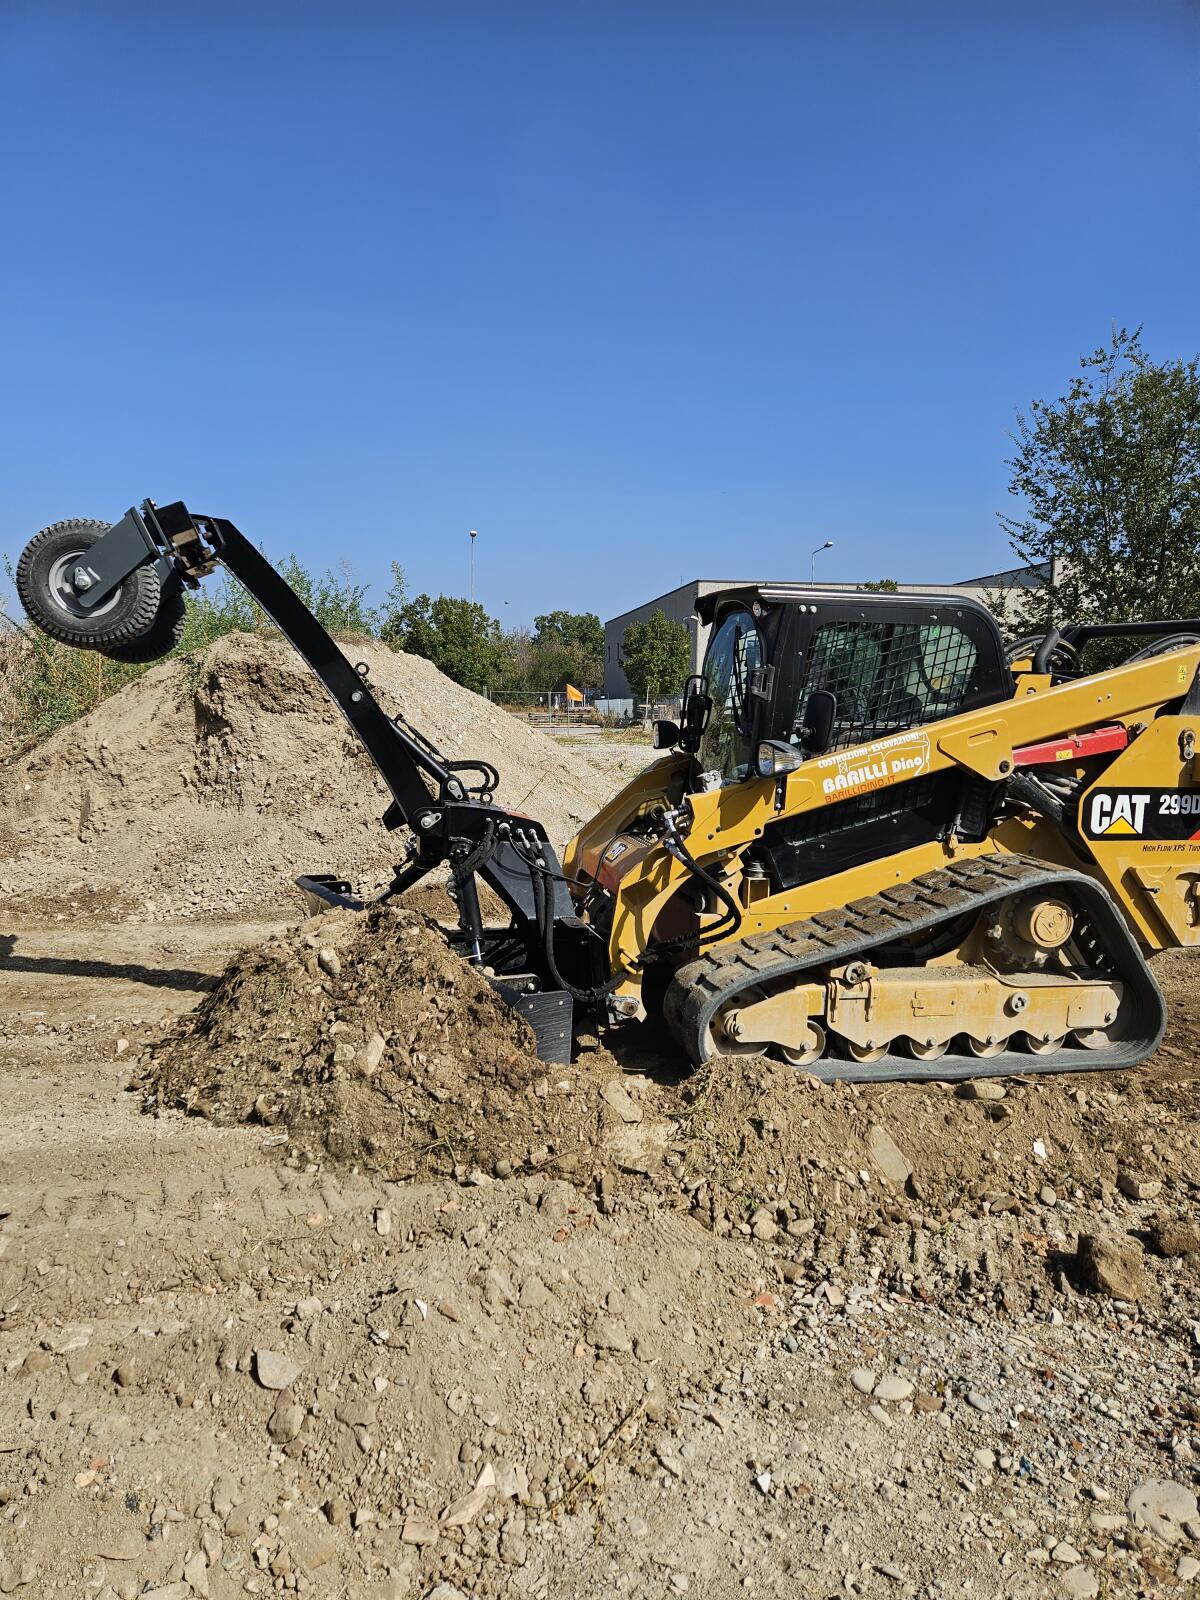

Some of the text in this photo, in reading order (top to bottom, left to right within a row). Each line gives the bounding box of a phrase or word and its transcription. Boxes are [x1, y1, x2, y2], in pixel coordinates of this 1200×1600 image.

[822, 757, 923, 793] BARILLI Dino
[825, 775, 896, 803] BARILLIDINO.IT
[1091, 794, 1150, 834] CAT
